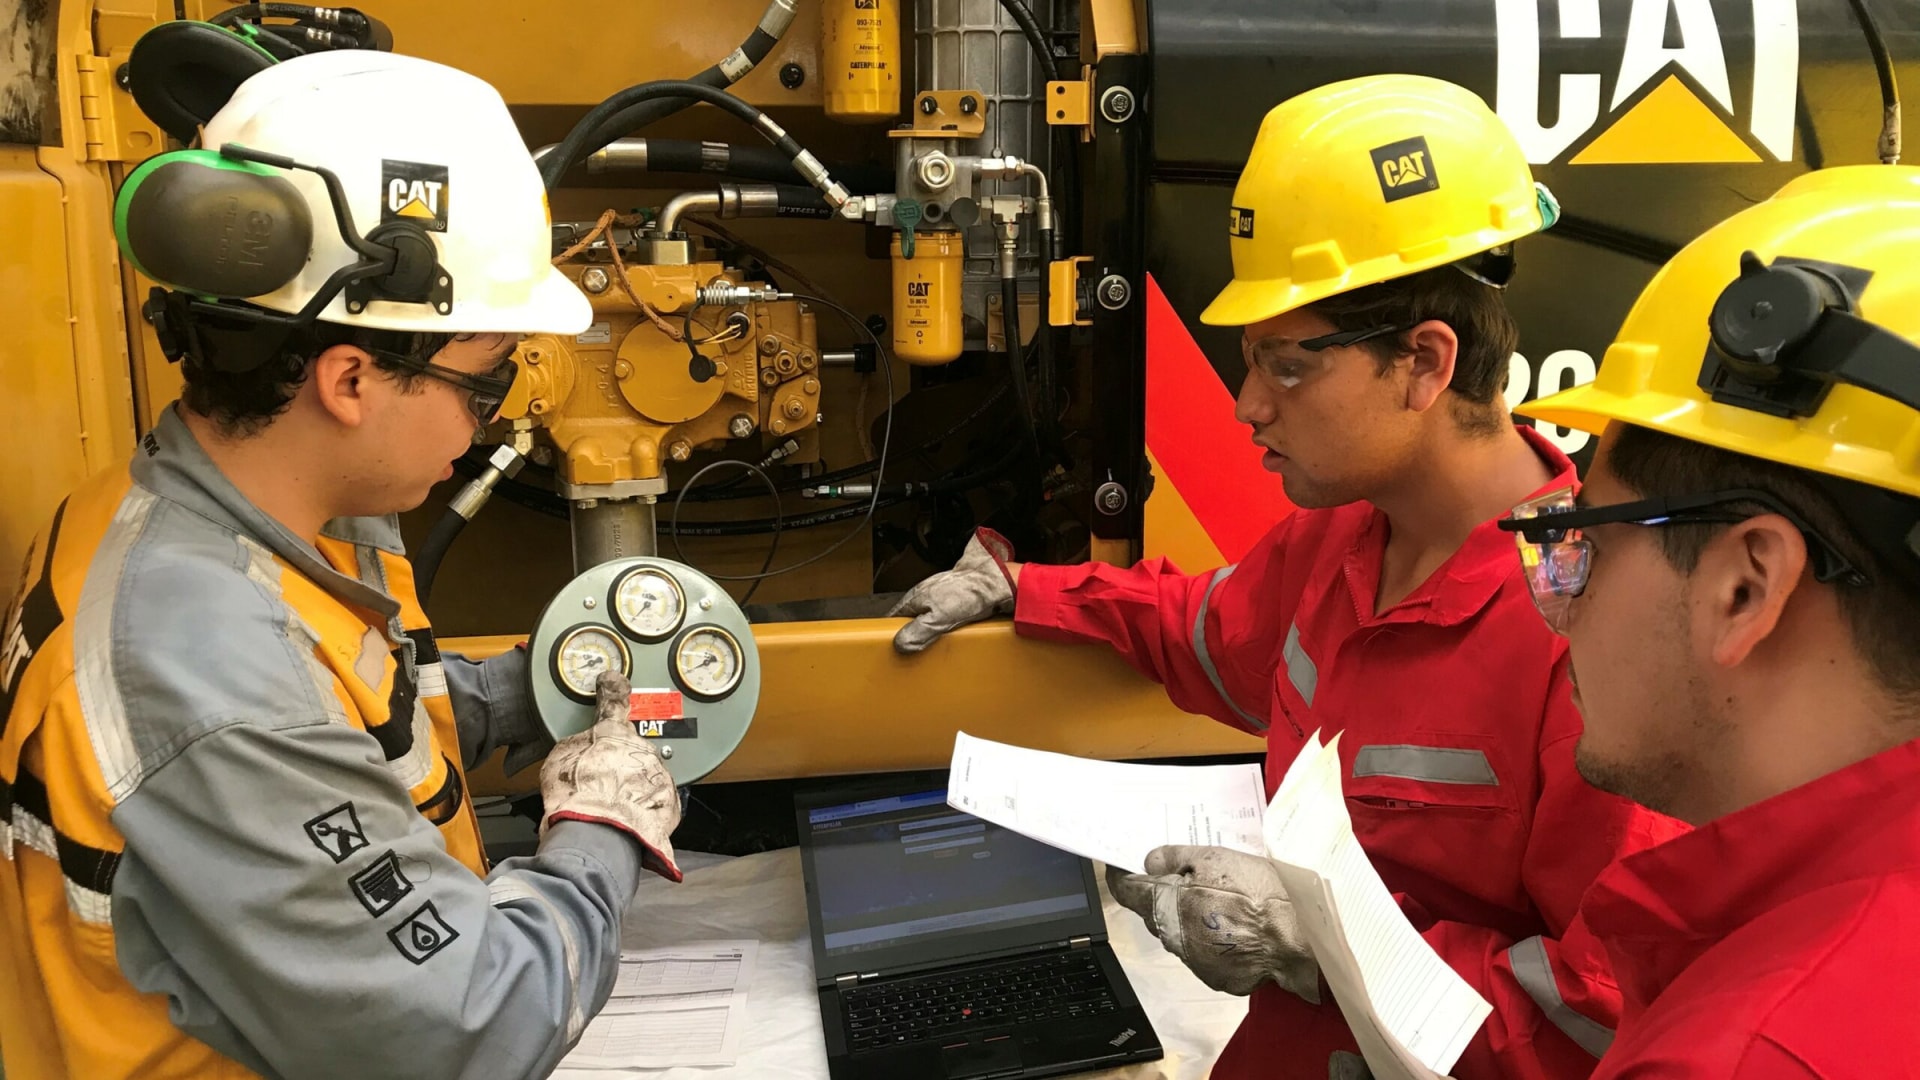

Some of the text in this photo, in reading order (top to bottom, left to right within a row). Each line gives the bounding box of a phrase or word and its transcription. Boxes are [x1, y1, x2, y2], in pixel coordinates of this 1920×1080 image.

[1496, 0, 1799, 164] CAT
[1382, 151, 1427, 188] CAT
[388, 178, 442, 219] CAT
[237, 210, 273, 266] 3M
[1240, 216, 1252, 231] CAT
[908, 282, 930, 296] CAT
[639, 720, 664, 736] CAT
